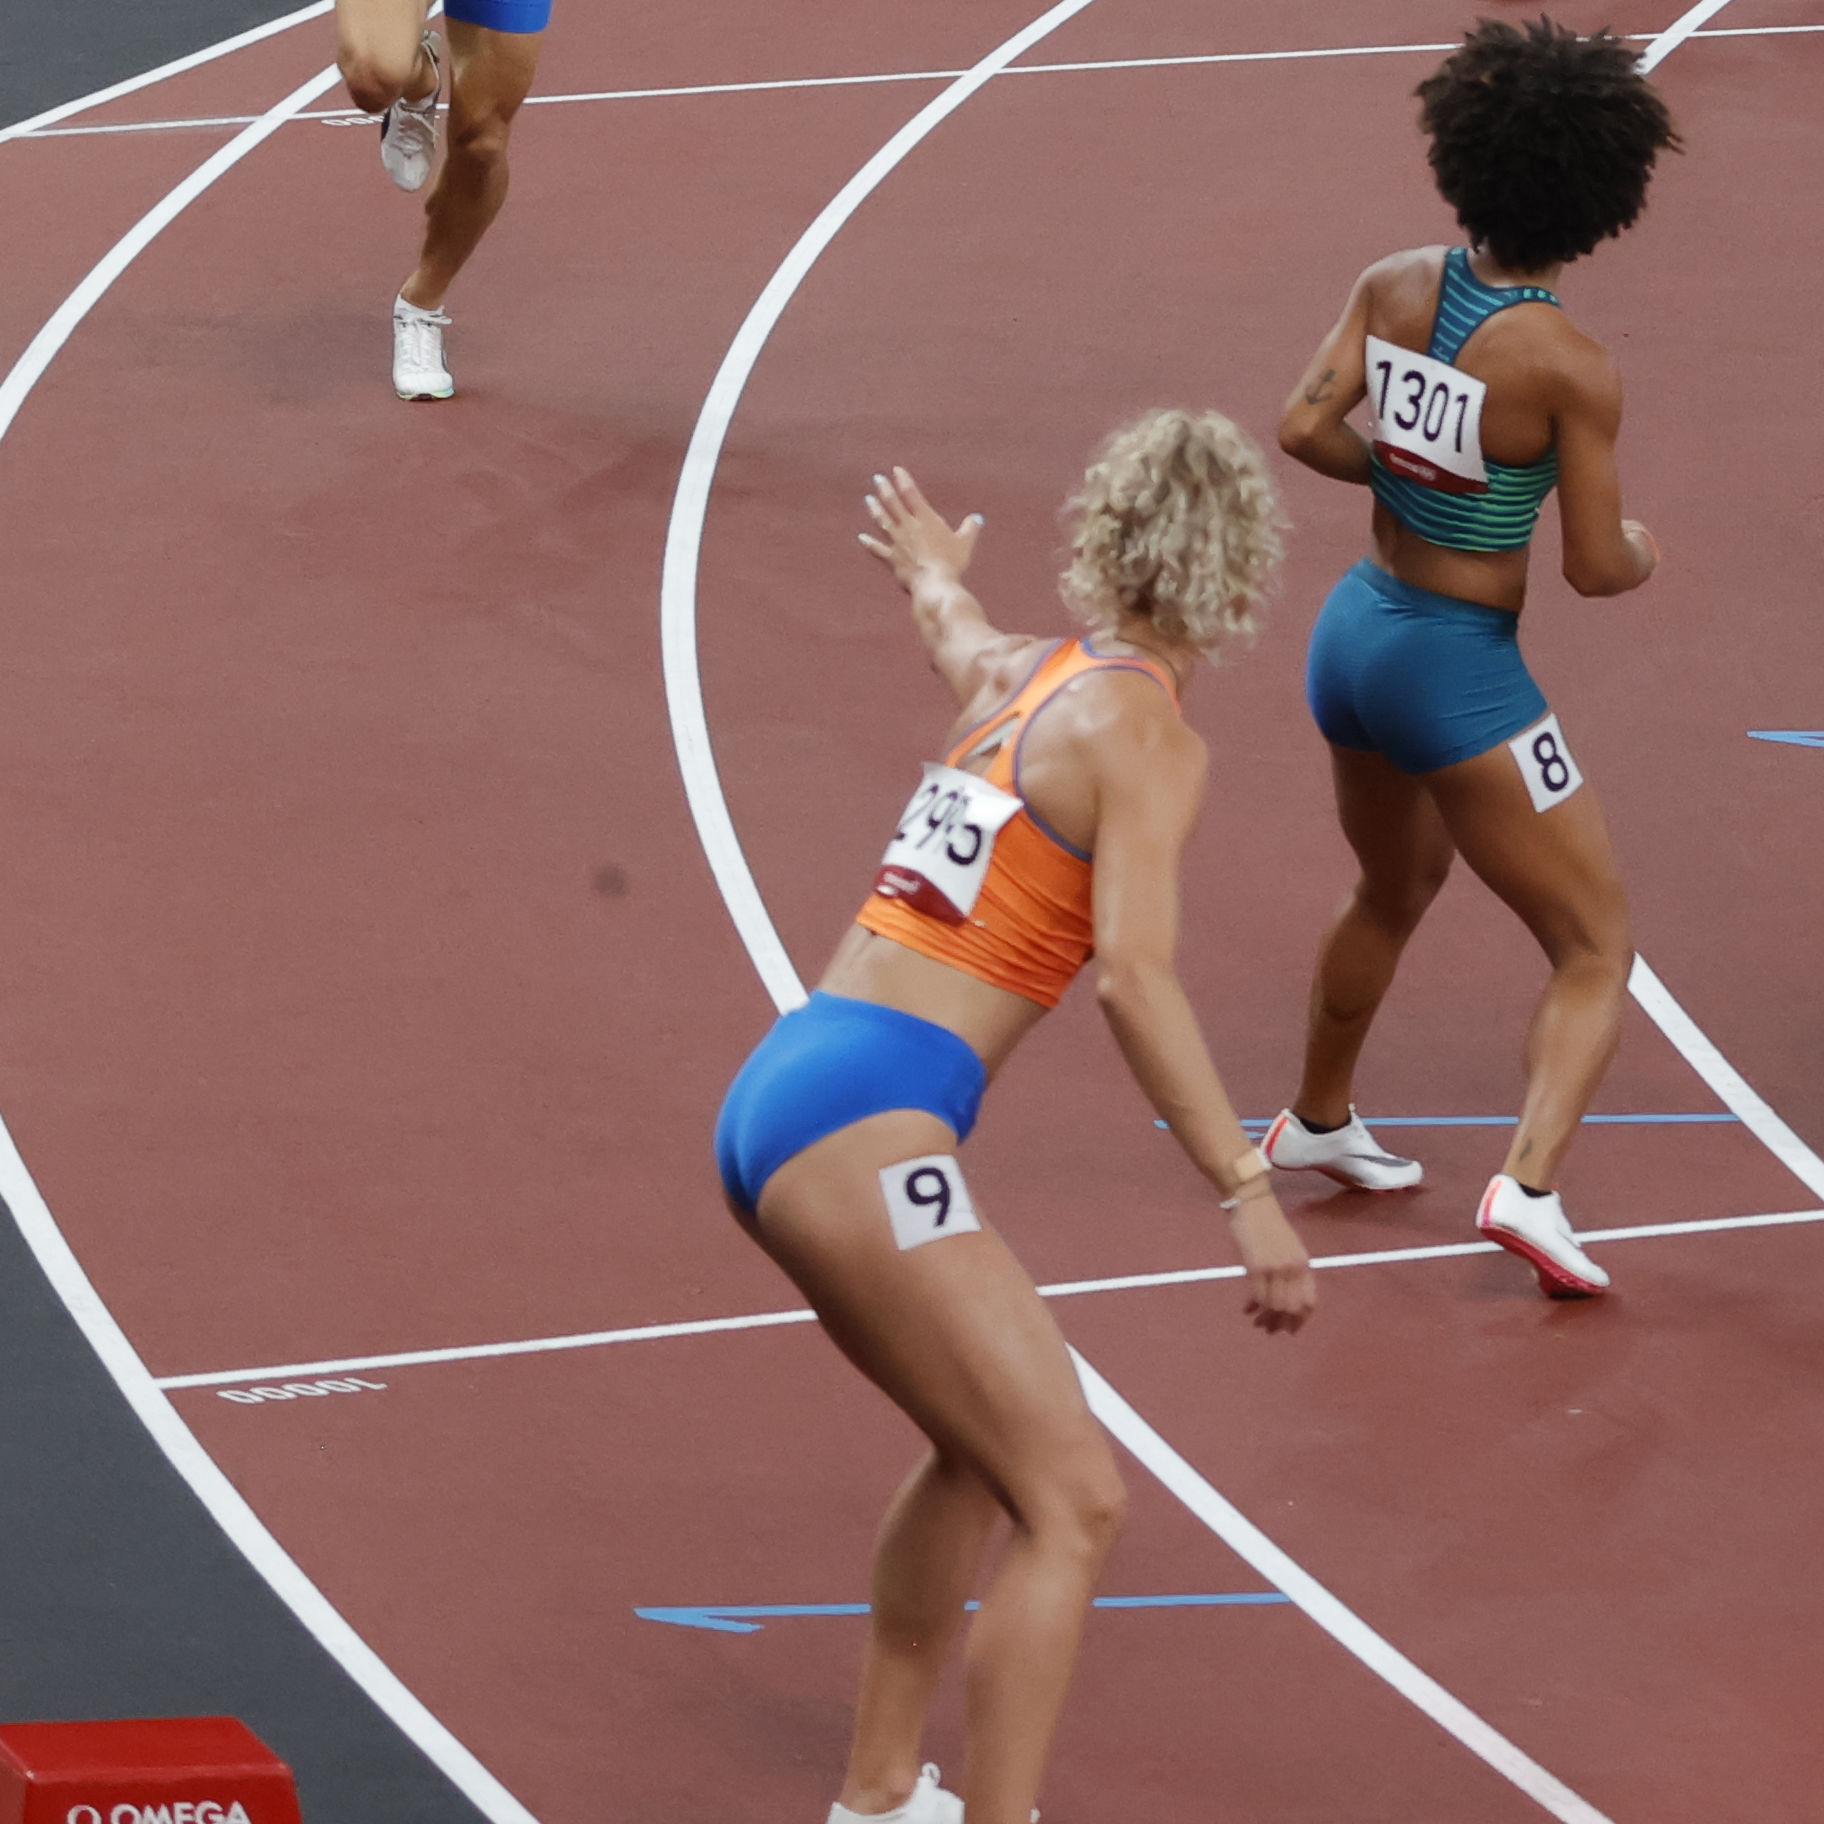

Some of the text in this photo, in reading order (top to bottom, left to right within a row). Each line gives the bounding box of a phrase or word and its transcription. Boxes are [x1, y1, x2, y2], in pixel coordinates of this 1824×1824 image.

[1376, 360, 1469, 454] 1301
[1531, 731, 1569, 792] 8
[905, 1166, 951, 1227] 9
[215, 1376, 388, 1405] 10000
[110, 1800, 252, 1824] OMEGA
